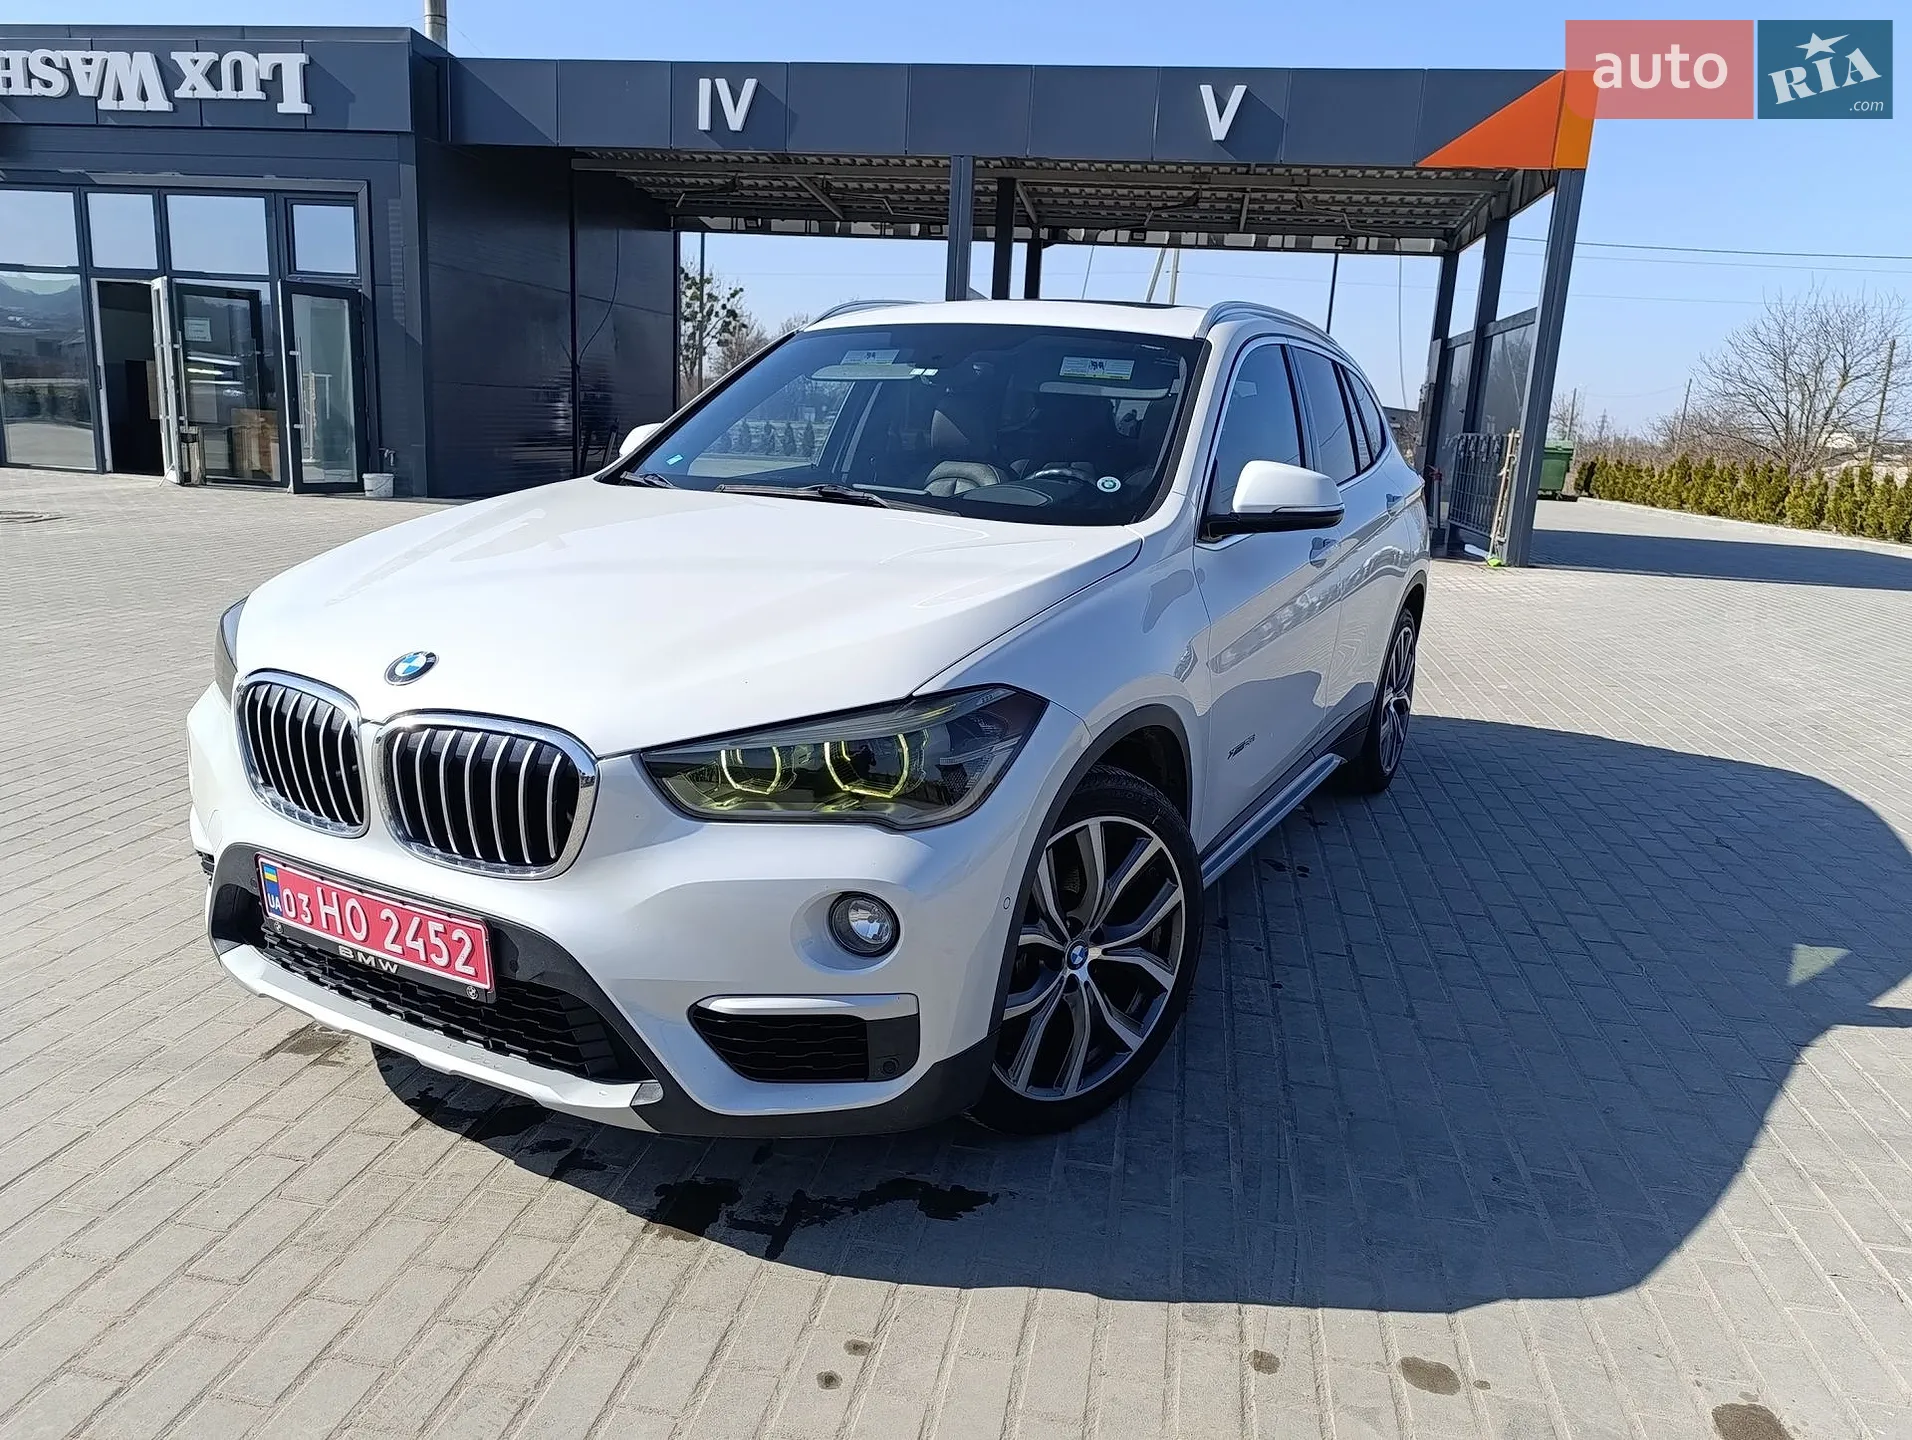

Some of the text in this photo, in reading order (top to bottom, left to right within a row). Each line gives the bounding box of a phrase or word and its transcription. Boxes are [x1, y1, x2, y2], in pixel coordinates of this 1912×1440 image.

[698, 78, 758, 131] IV
[1200, 84, 1247, 141] V
[267, 893, 282, 912] UA
[283, 888, 313, 924] 03
[380, 908, 477, 976] 2452
[338, 945, 398, 973] BMW
